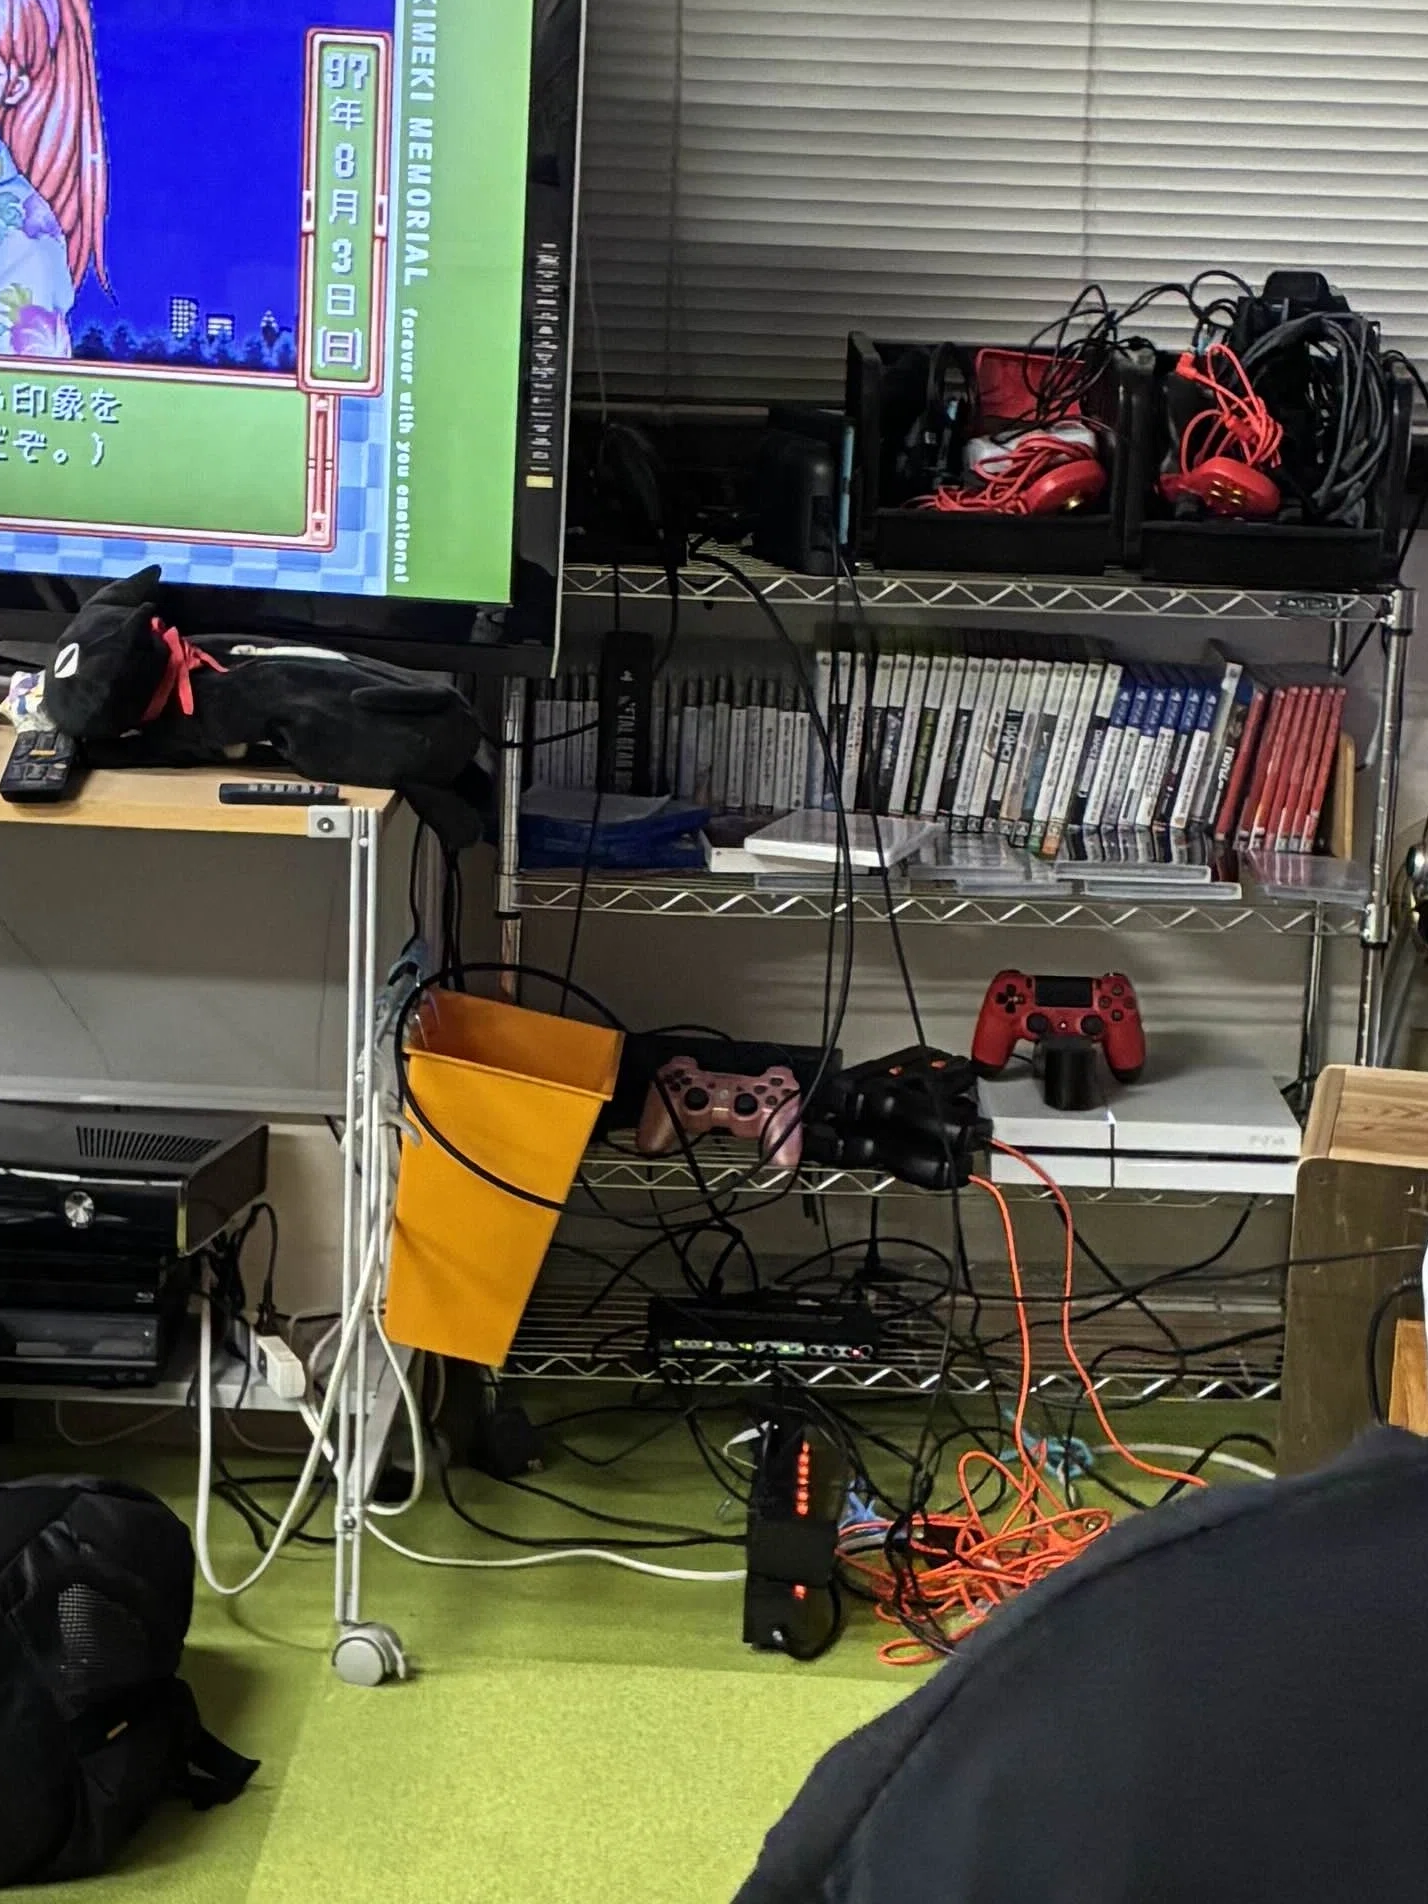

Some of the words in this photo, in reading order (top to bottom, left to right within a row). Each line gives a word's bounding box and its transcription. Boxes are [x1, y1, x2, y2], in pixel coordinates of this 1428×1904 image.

[404, 116, 433, 286] MEMORIAL
[400, 307, 418, 385] forever
[398, 392, 416, 434] with
[395, 441, 411, 477] you
[394, 487, 411, 584] emotional
